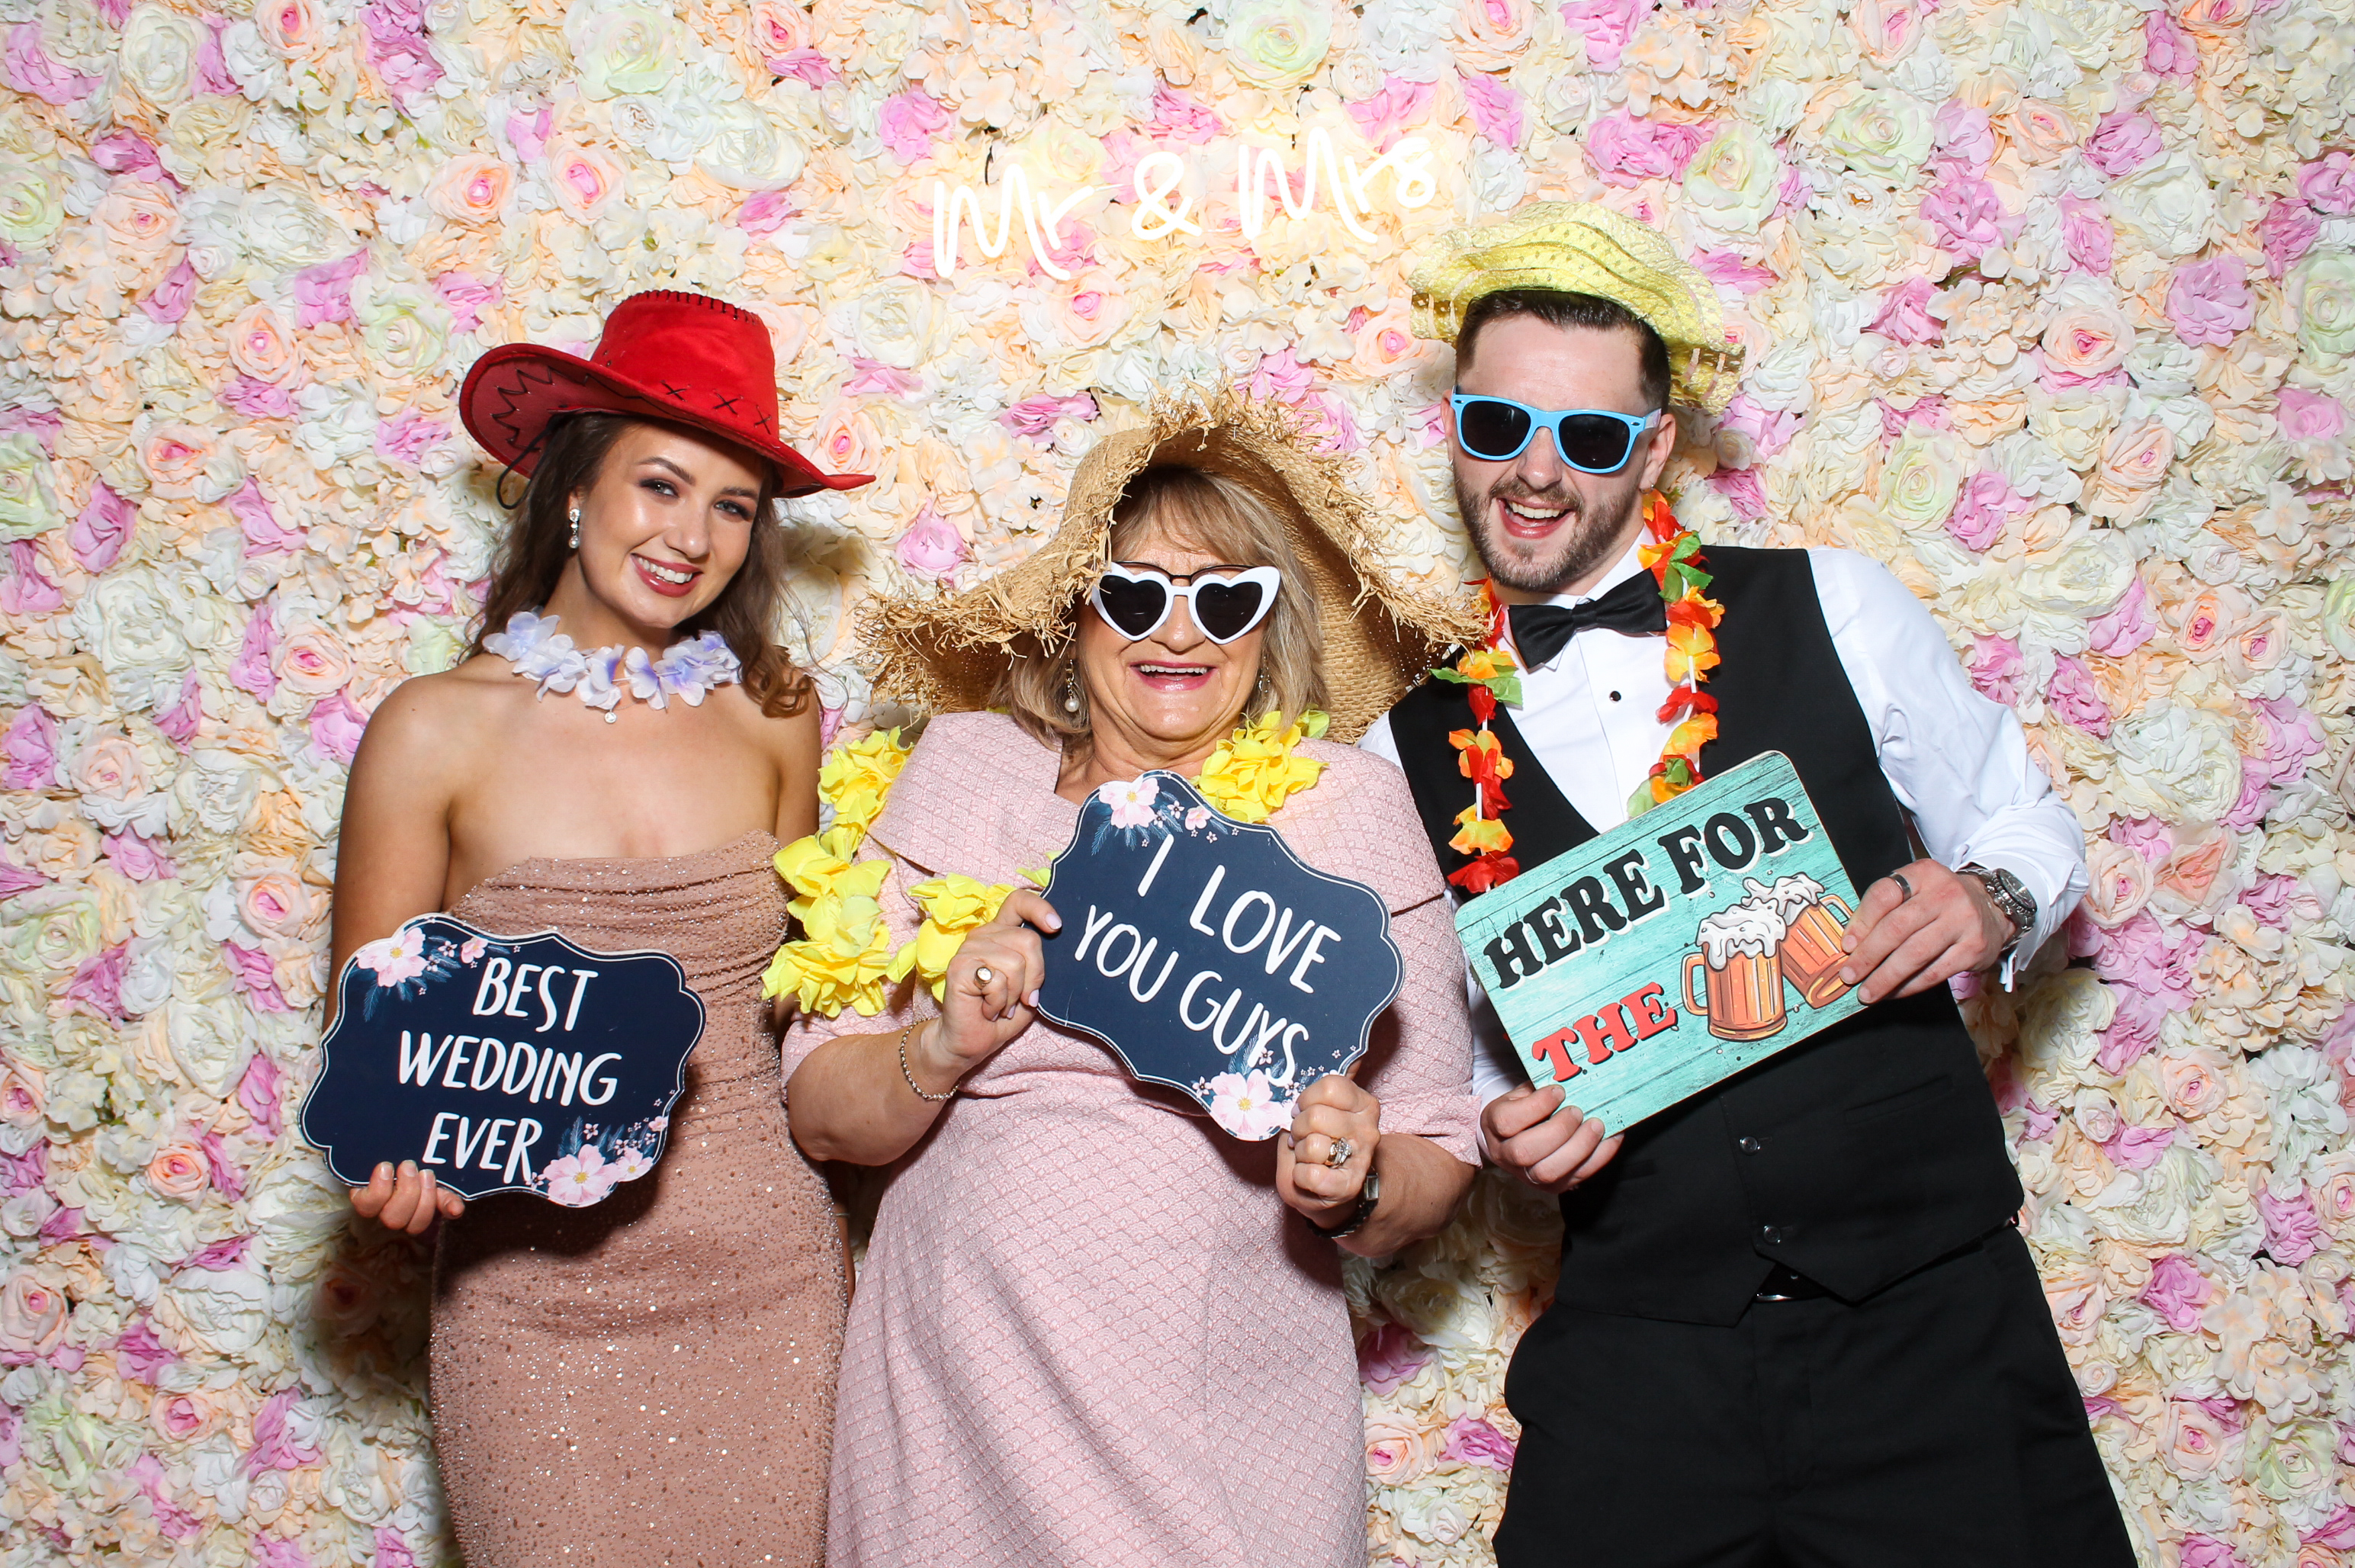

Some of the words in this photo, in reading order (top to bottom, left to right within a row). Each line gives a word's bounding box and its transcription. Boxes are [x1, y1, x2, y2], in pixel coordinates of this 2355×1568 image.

[933, 163, 1095, 281] Mr
[1239, 126, 1436, 243] Mrs
[1138, 834, 1174, 897] I
[1190, 865, 1341, 994] LOVE
[1483, 848, 1670, 991] HERE
[1658, 797, 1814, 897] FOR
[472, 956, 599, 1032] BEST
[1075, 904, 1179, 1003] YOU
[1180, 971, 1309, 1086] GUYS
[1531, 982, 1678, 1082] THE
[399, 1030, 623, 1106] WEDDING
[422, 1112, 543, 1184] EVER
